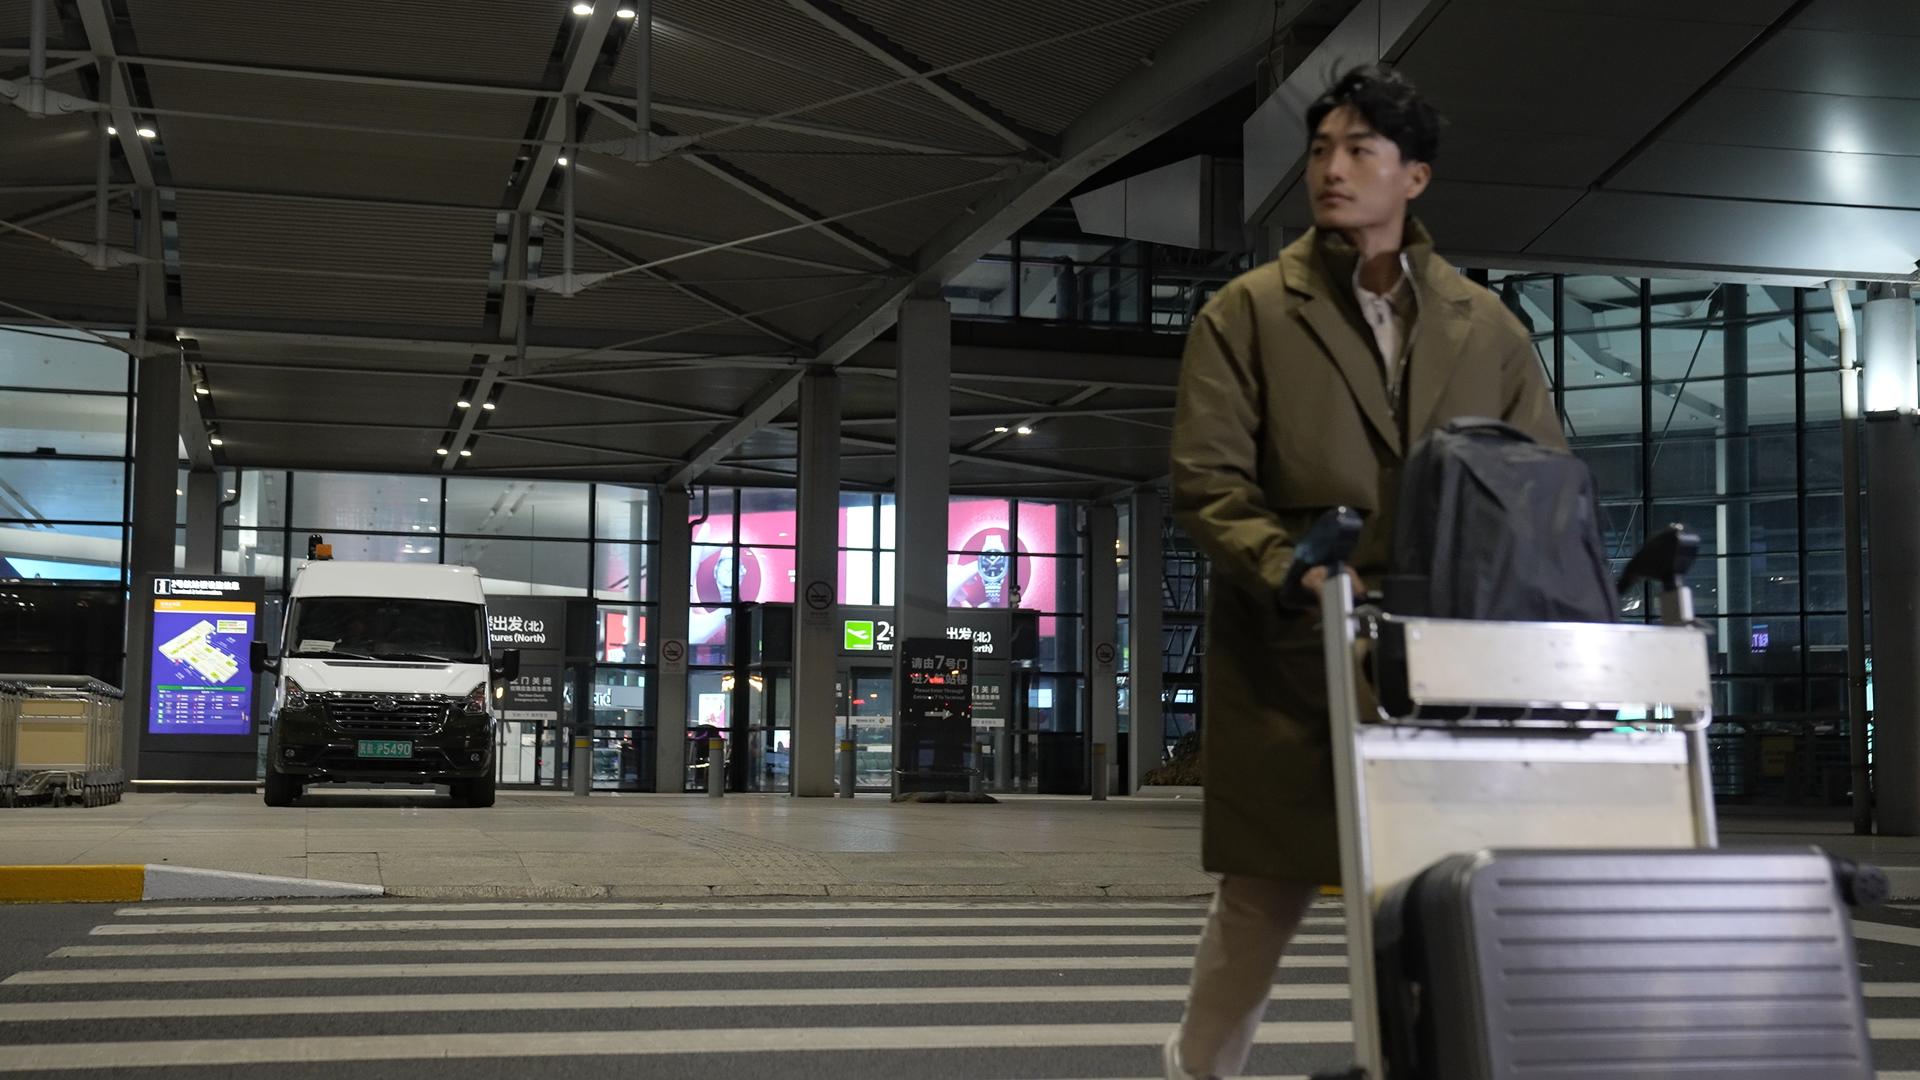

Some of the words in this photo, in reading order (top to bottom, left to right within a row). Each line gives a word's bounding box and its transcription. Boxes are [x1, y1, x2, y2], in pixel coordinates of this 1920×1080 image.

[490, 633, 513, 642] tures
[513, 632, 546, 644] (North)
[973, 641, 993, 654] orth)
[911, 655, 968, 670] 请由7号门
[971, 685, 1000, 694] 门关闭
